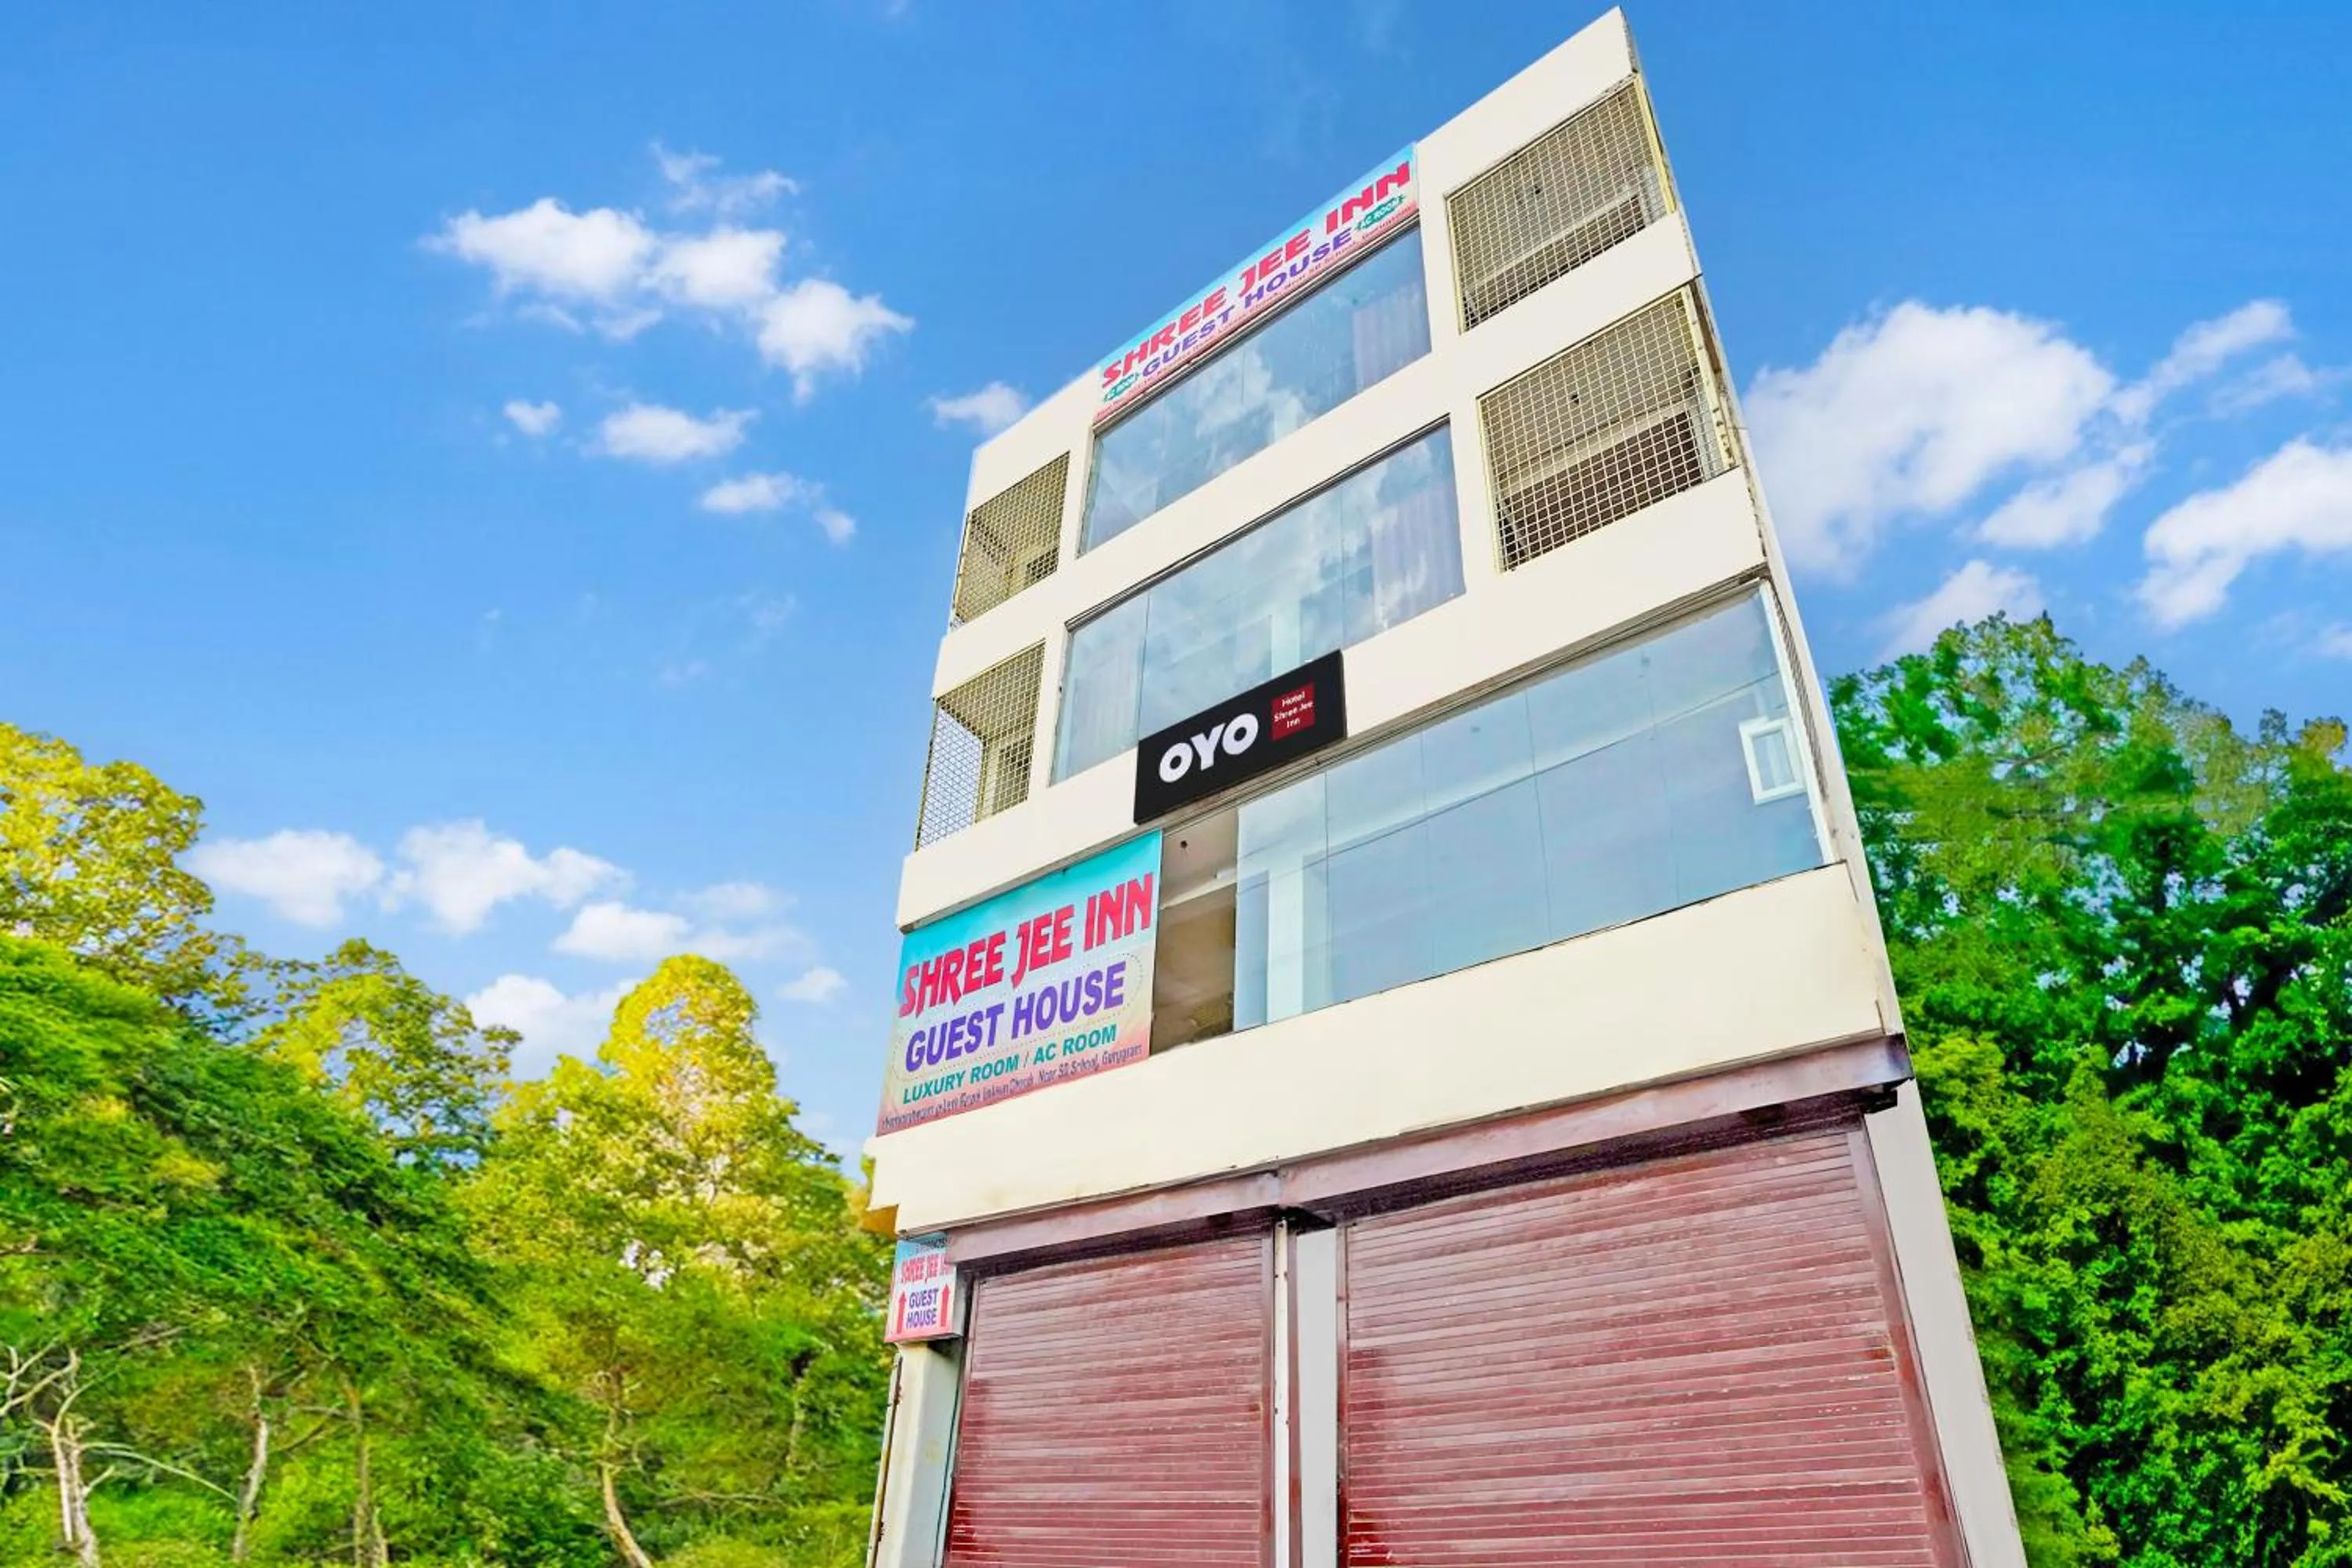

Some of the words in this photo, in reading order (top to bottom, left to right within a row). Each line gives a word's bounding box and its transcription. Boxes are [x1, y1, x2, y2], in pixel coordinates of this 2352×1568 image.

[1102, 285, 1227, 389] SHREE
[1238, 228, 1312, 297] JEE
[1326, 159, 1410, 235] INN
[1142, 305, 1234, 379] GUEST
[1244, 227, 1352, 309] HOUSE
[1273, 707, 1298, 722] Shree
[1299, 701, 1313, 711] Jee
[1282, 691, 1305, 707] Hotel
[1287, 717, 1300, 728] Inn
[1159, 713, 1259, 782] OYO
[898, 930, 1007, 1018] SHREE
[1011, 904, 1075, 989] JEE
[1083, 872, 1154, 952] INN
[905, 1002, 1004, 1073] GUEST
[1011, 960, 1127, 1040] HOUSE
[902, 1070, 966, 1105] LUXURY
[970, 1053, 1020, 1085] ROOM
[1033, 1042, 1057, 1065] AC
[1062, 1024, 1117, 1051] ROOM
[906, 1308, 938, 1329] HOUSE
[909, 1288, 939, 1308] GUEST
